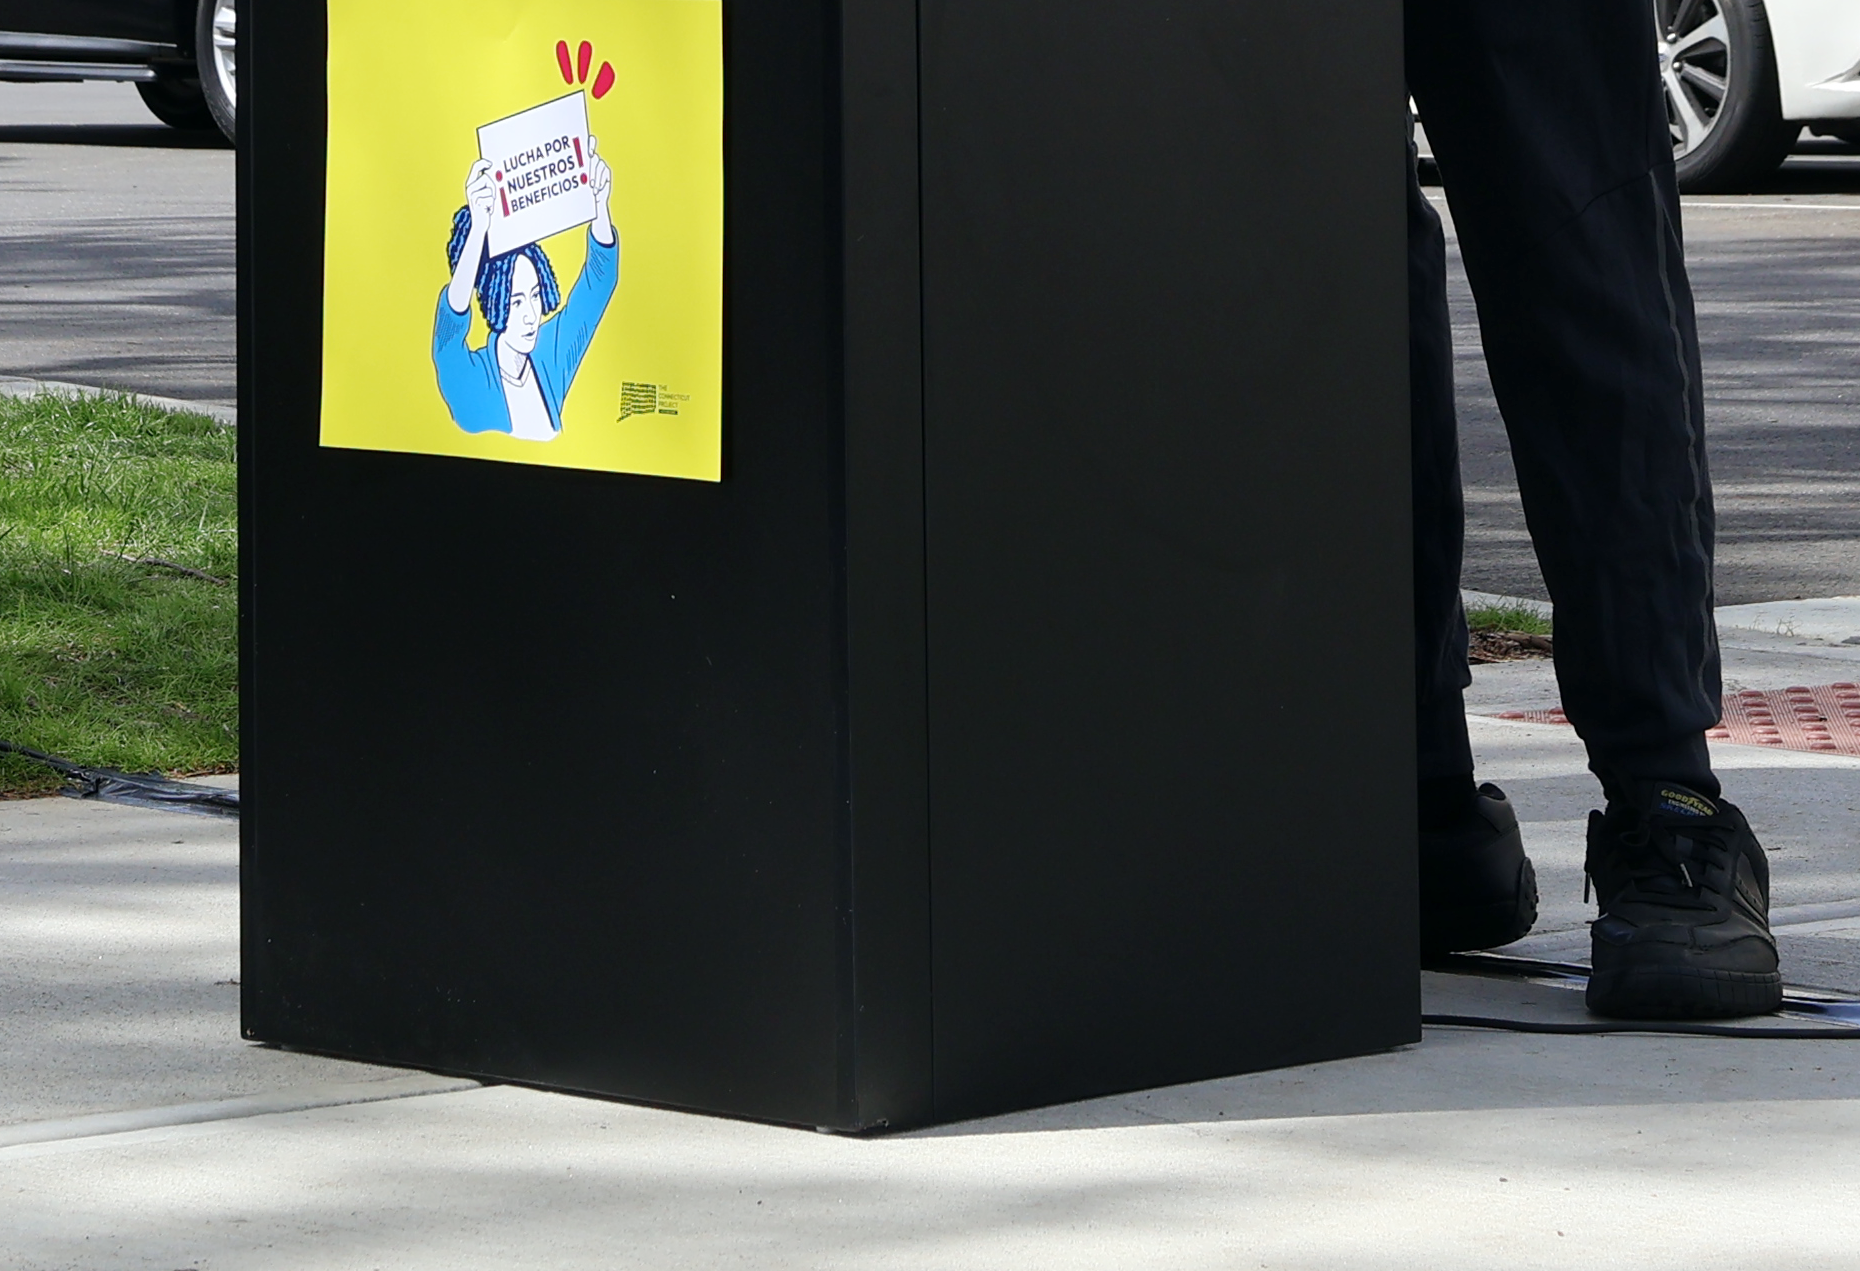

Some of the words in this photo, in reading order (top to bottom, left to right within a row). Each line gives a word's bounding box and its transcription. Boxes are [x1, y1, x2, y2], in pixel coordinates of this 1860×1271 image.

[503, 146, 545, 173] LUCHA
[544, 135, 571, 157] POR
[507, 154, 575, 194] NUESTROS
[510, 175, 579, 213] BENEFICIOS
